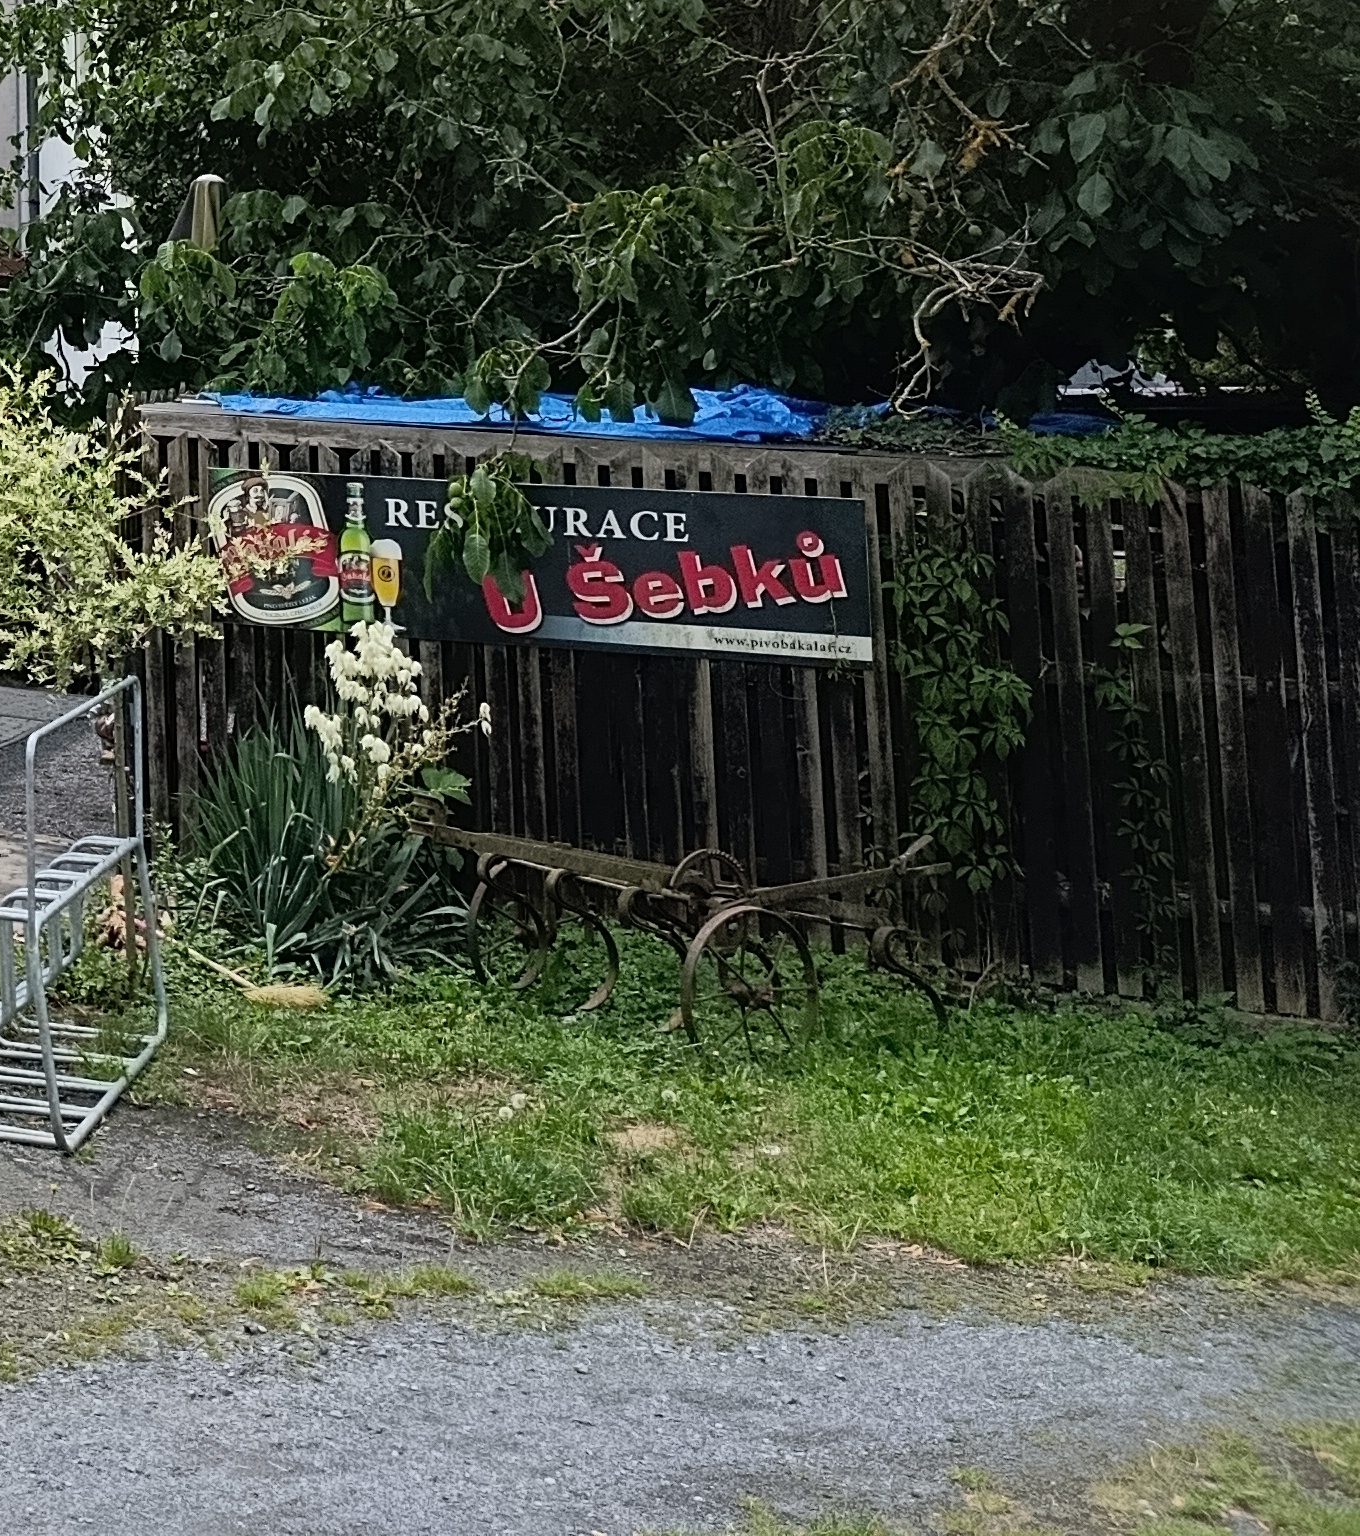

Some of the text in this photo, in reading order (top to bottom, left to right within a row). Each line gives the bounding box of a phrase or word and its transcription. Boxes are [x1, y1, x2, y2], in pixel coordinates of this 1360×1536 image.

[385, 498, 689, 543] RESRACE
[483, 530, 848, 634] U Šebků
